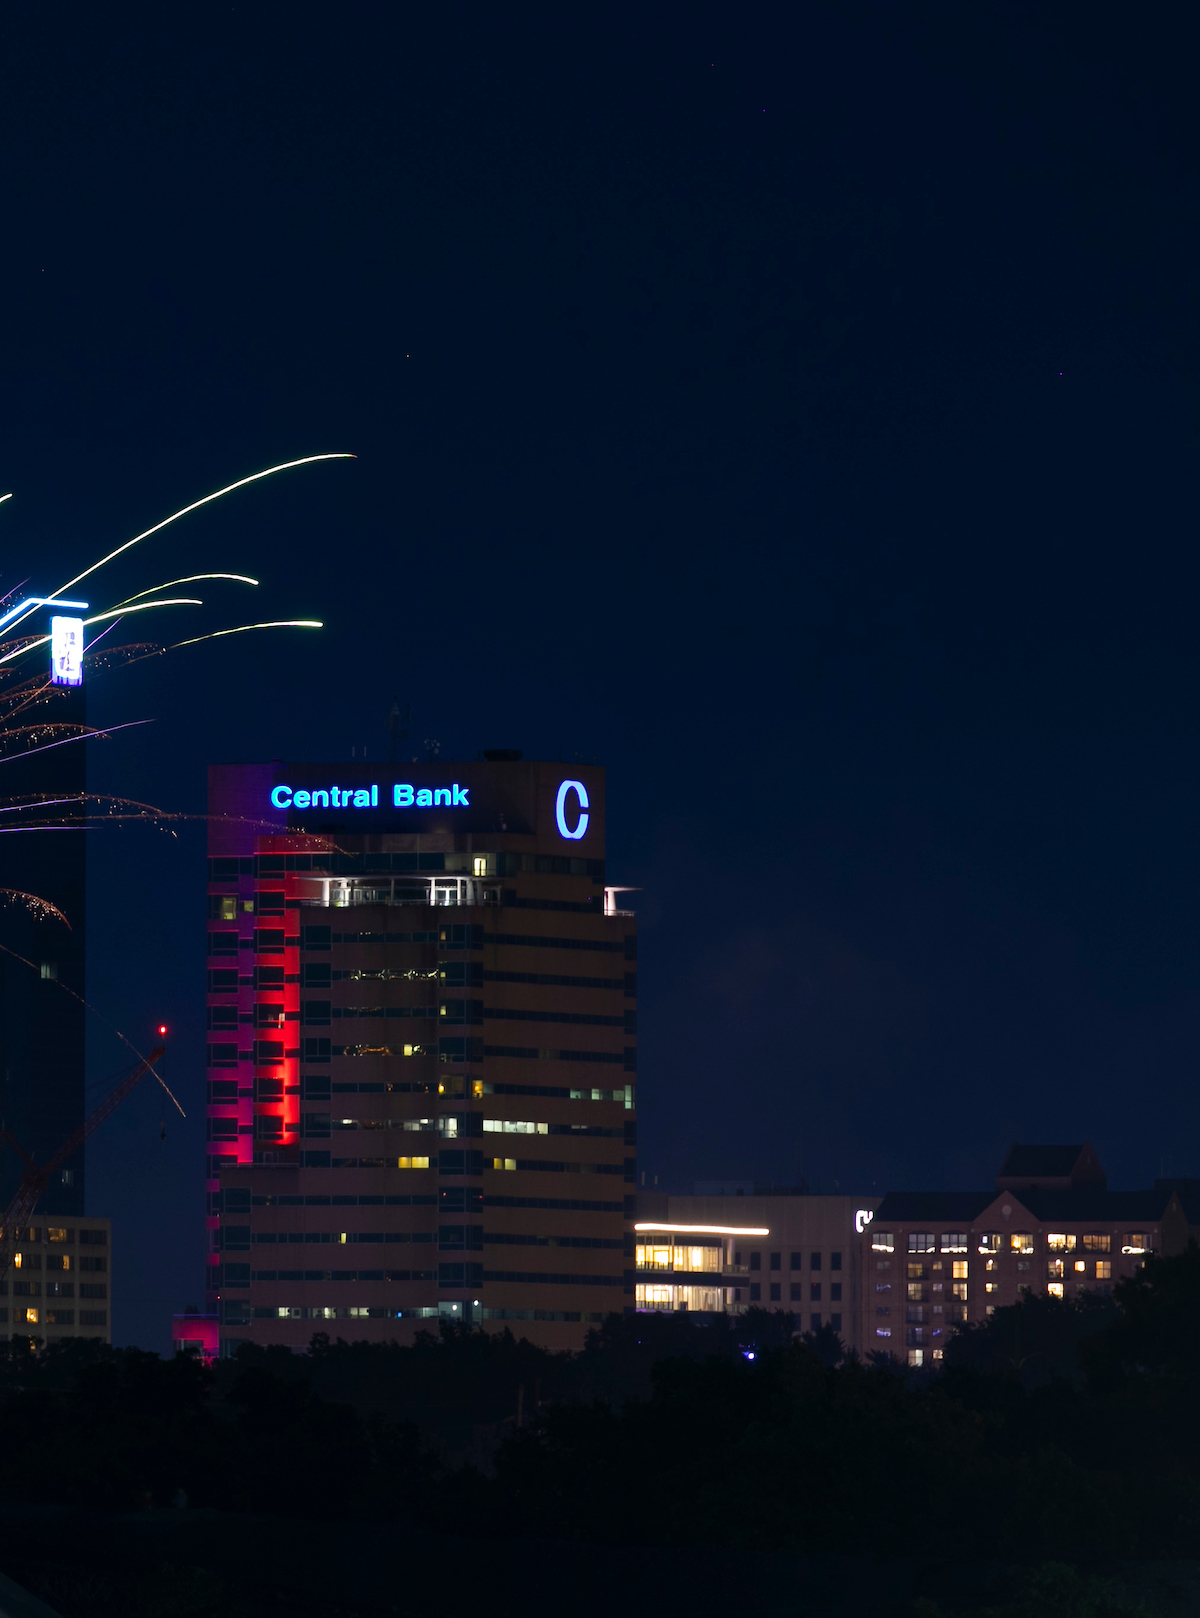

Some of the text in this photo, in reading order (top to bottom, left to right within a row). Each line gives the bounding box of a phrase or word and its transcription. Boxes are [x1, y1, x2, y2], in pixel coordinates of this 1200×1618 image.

[270, 784, 470, 809] Central Bank
[556, 780, 589, 840] C
